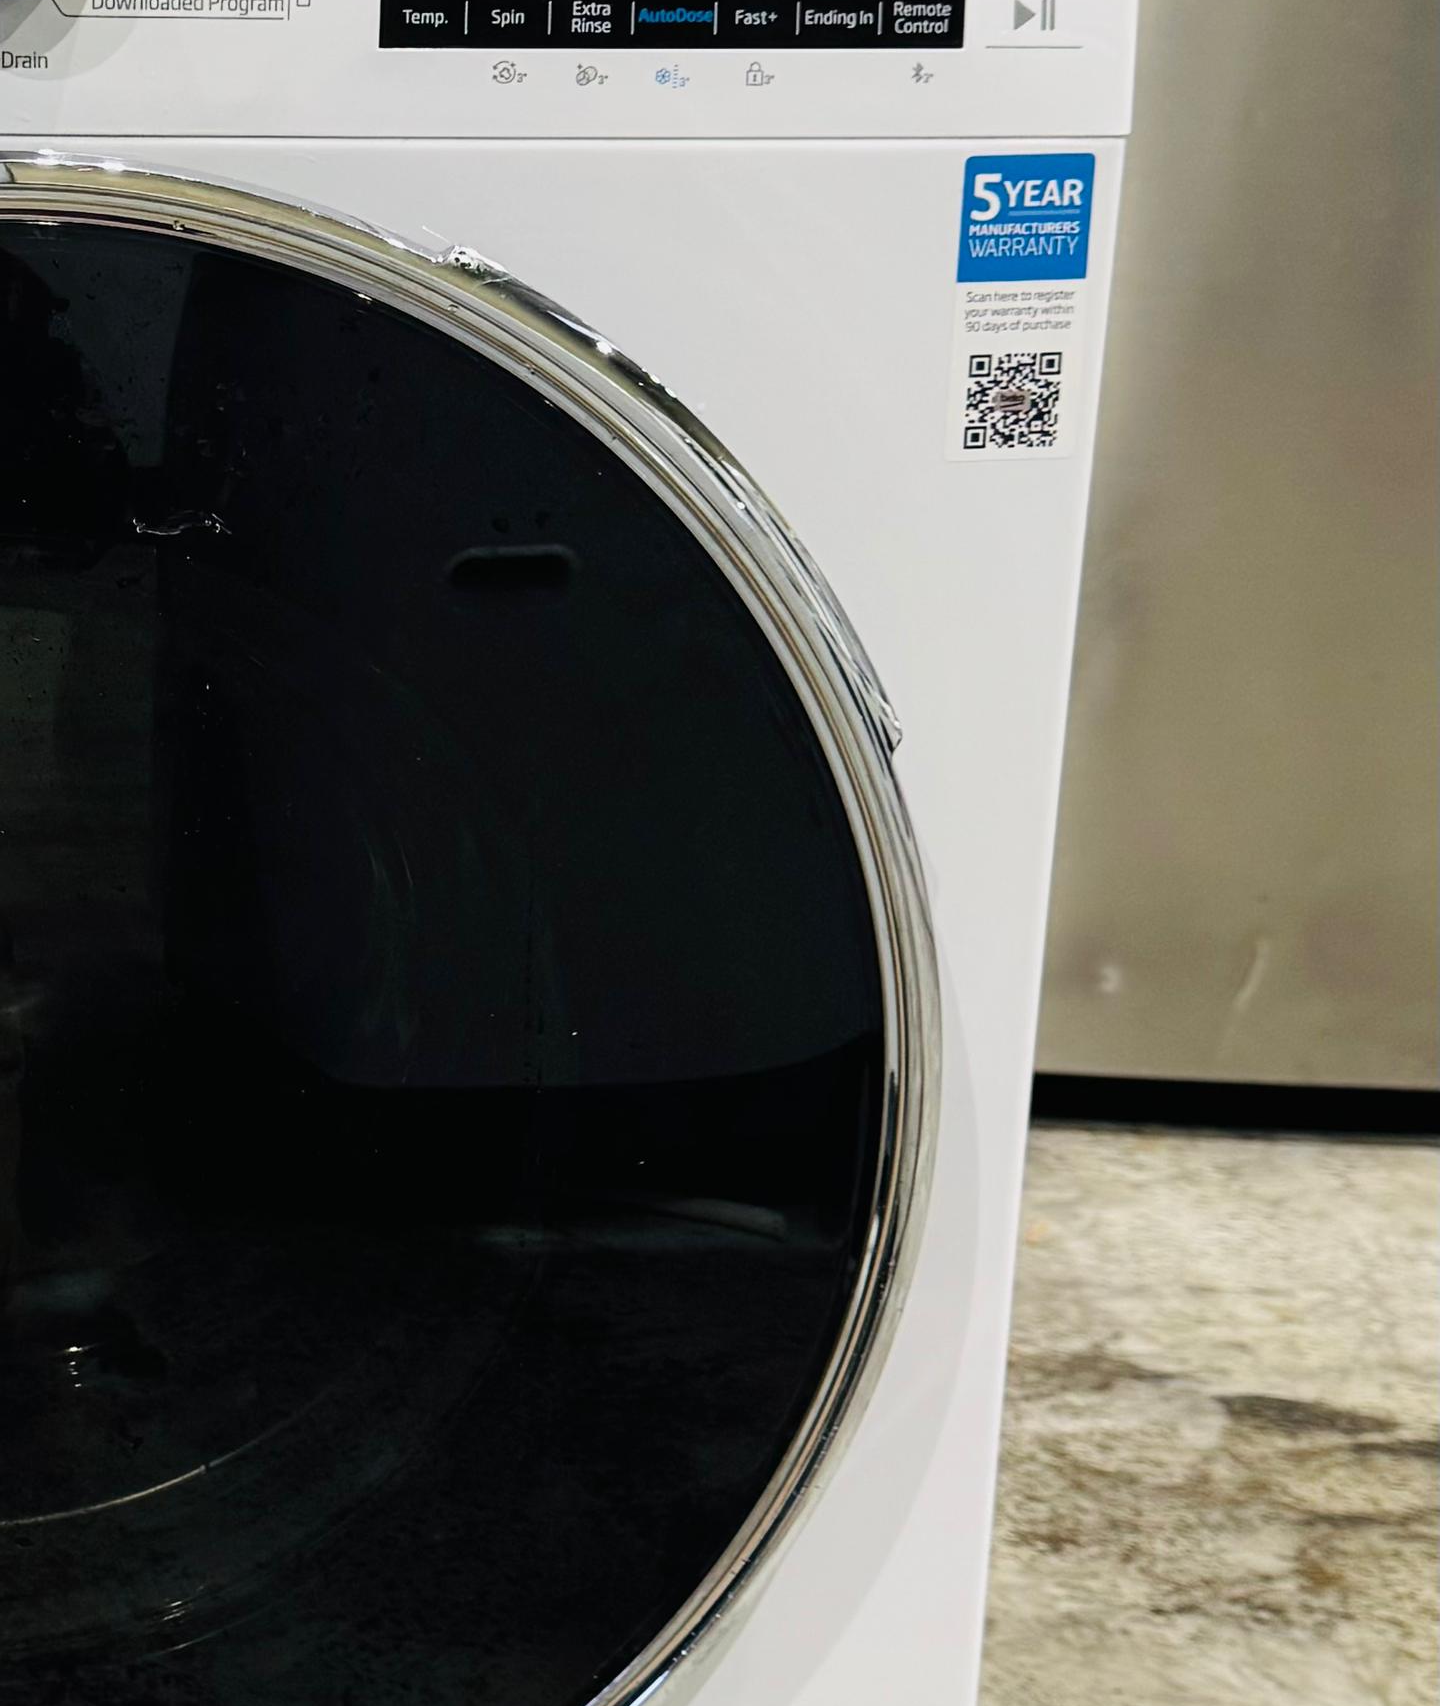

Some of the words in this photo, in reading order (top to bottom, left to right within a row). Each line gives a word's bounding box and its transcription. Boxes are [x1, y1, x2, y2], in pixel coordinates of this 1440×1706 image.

[572, 0, 611, 16] Extra
[638, 7, 713, 24] AutoDose
[893, 1, 952, 17] Remote
[402, 9, 449, 28] Temp.
[491, 9, 525, 28] Spin
[571, 18, 612, 33] Rinse
[734, 9, 778, 26] Fast+
[804, 9, 856, 29] Ending
[860, 10, 874, 26] In
[894, 18, 949, 34] Control
[970, 173, 1002, 221] 5
[1003, 179, 1084, 207] YEAR
[969, 221, 1080, 236] MANUFACTURERS
[968, 236, 1079, 258] WARRANTY
[966, 291, 992, 303] Scan
[994, 292, 1018, 302] here
[991, 306, 1038, 318] warranty
